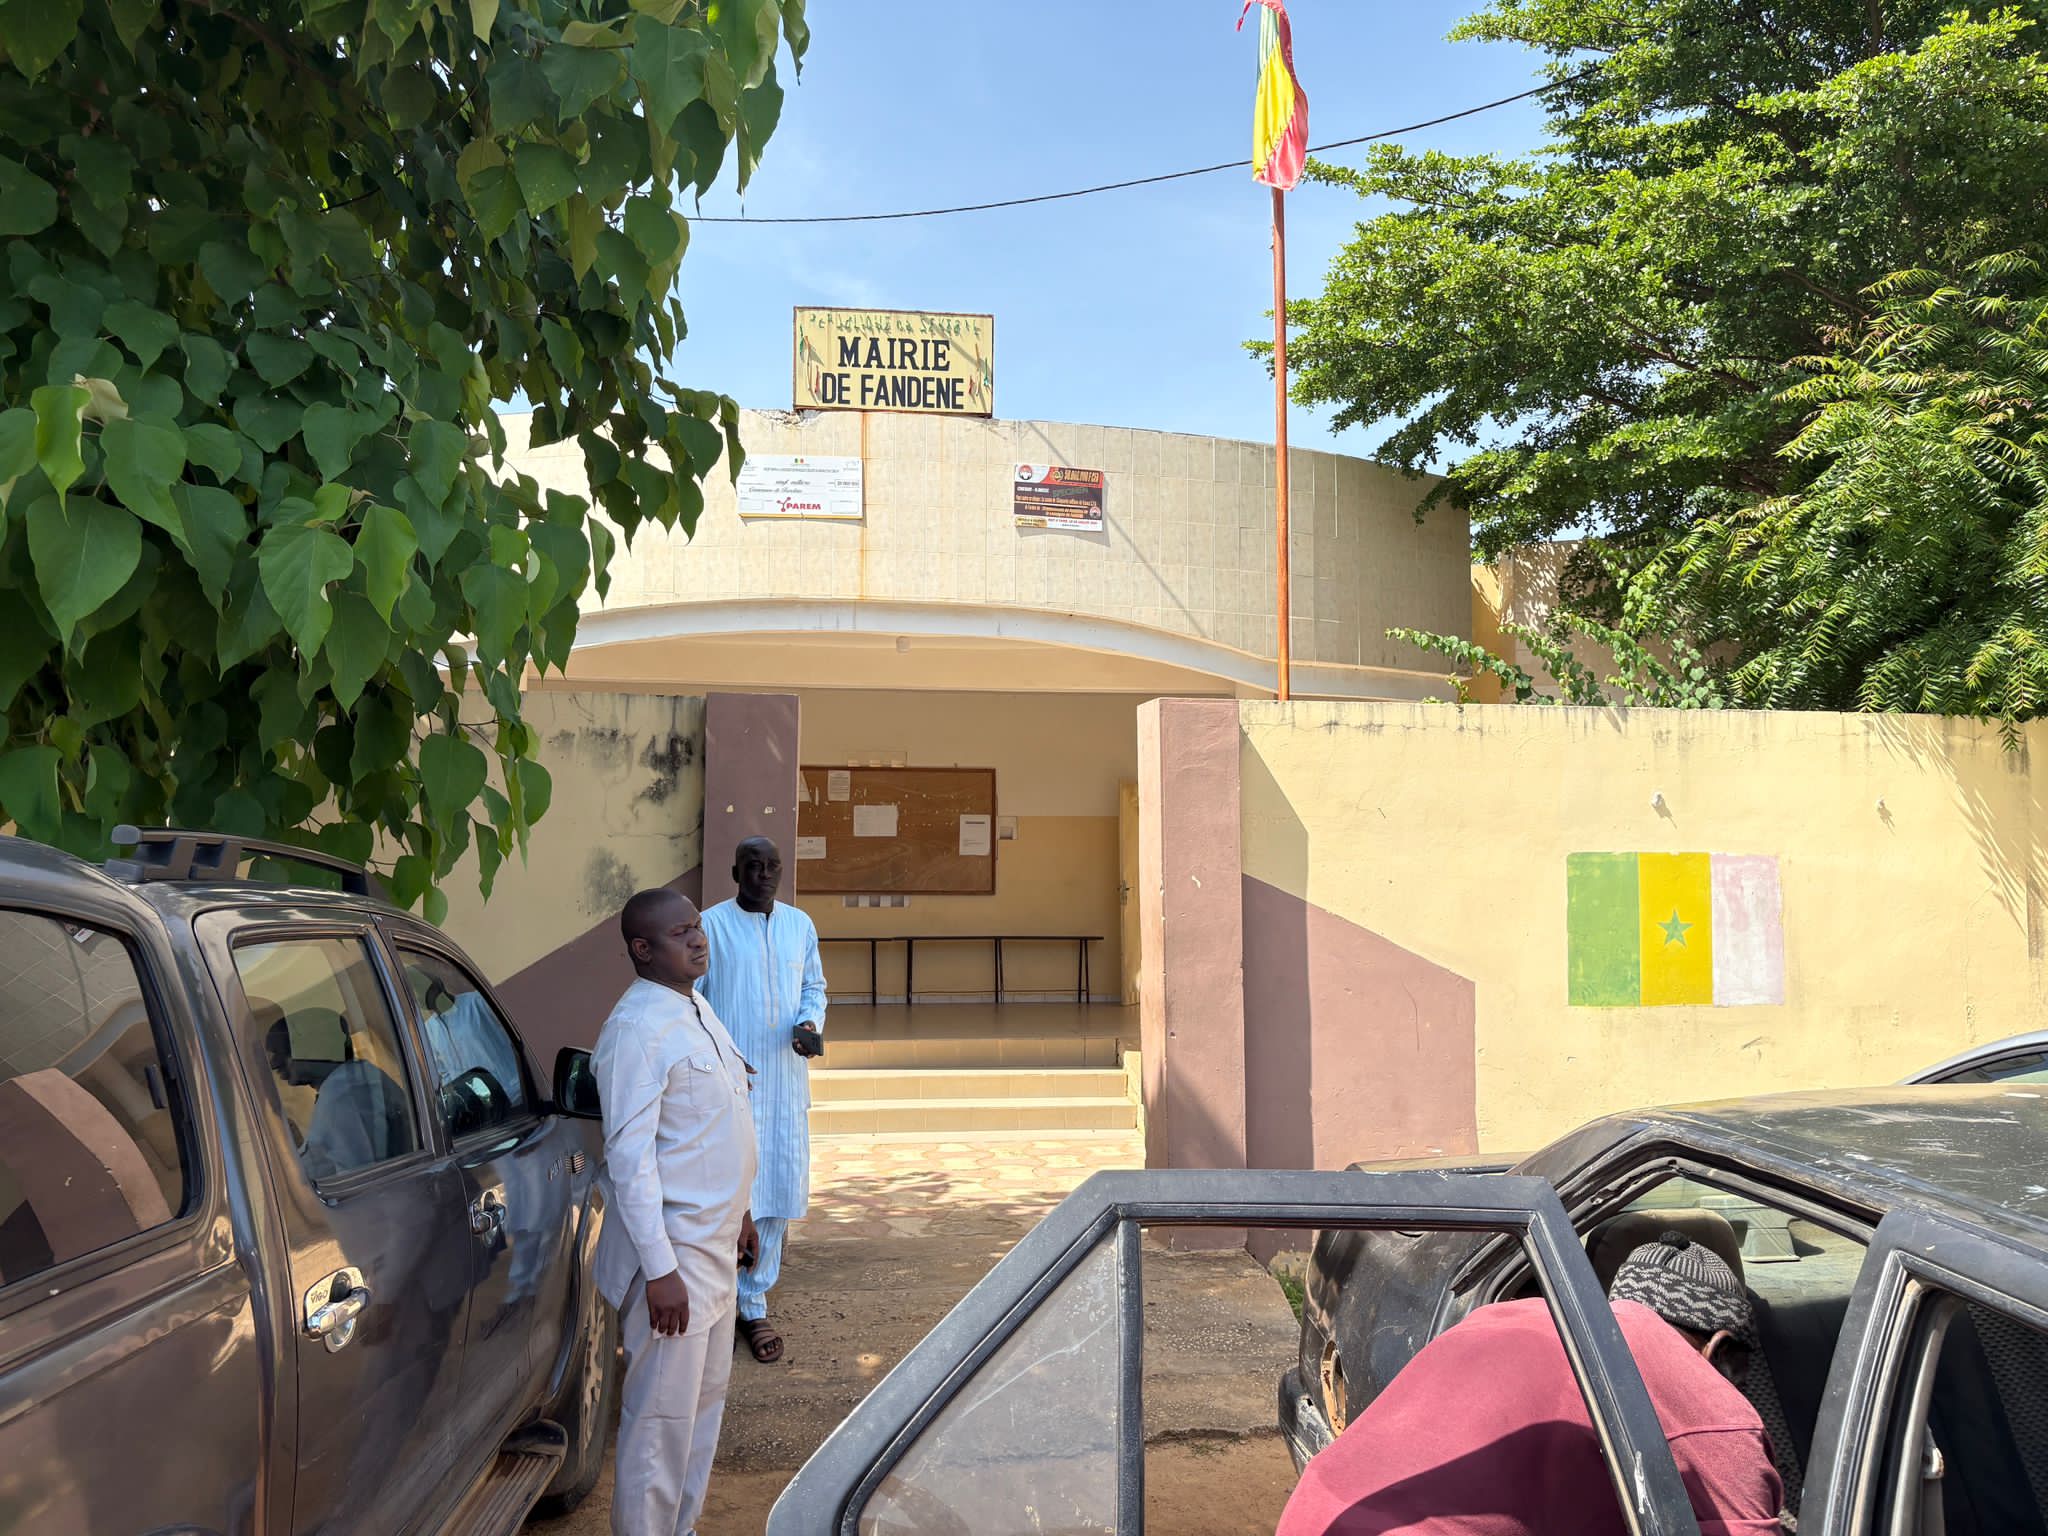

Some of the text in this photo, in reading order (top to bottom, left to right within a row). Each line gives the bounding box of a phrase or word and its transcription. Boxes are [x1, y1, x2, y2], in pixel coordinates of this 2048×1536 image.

[838, 336, 950, 371] MAIRIE
[822, 373, 964, 409] DE FANDENE
[311, 1290, 328, 1303] VIGO
